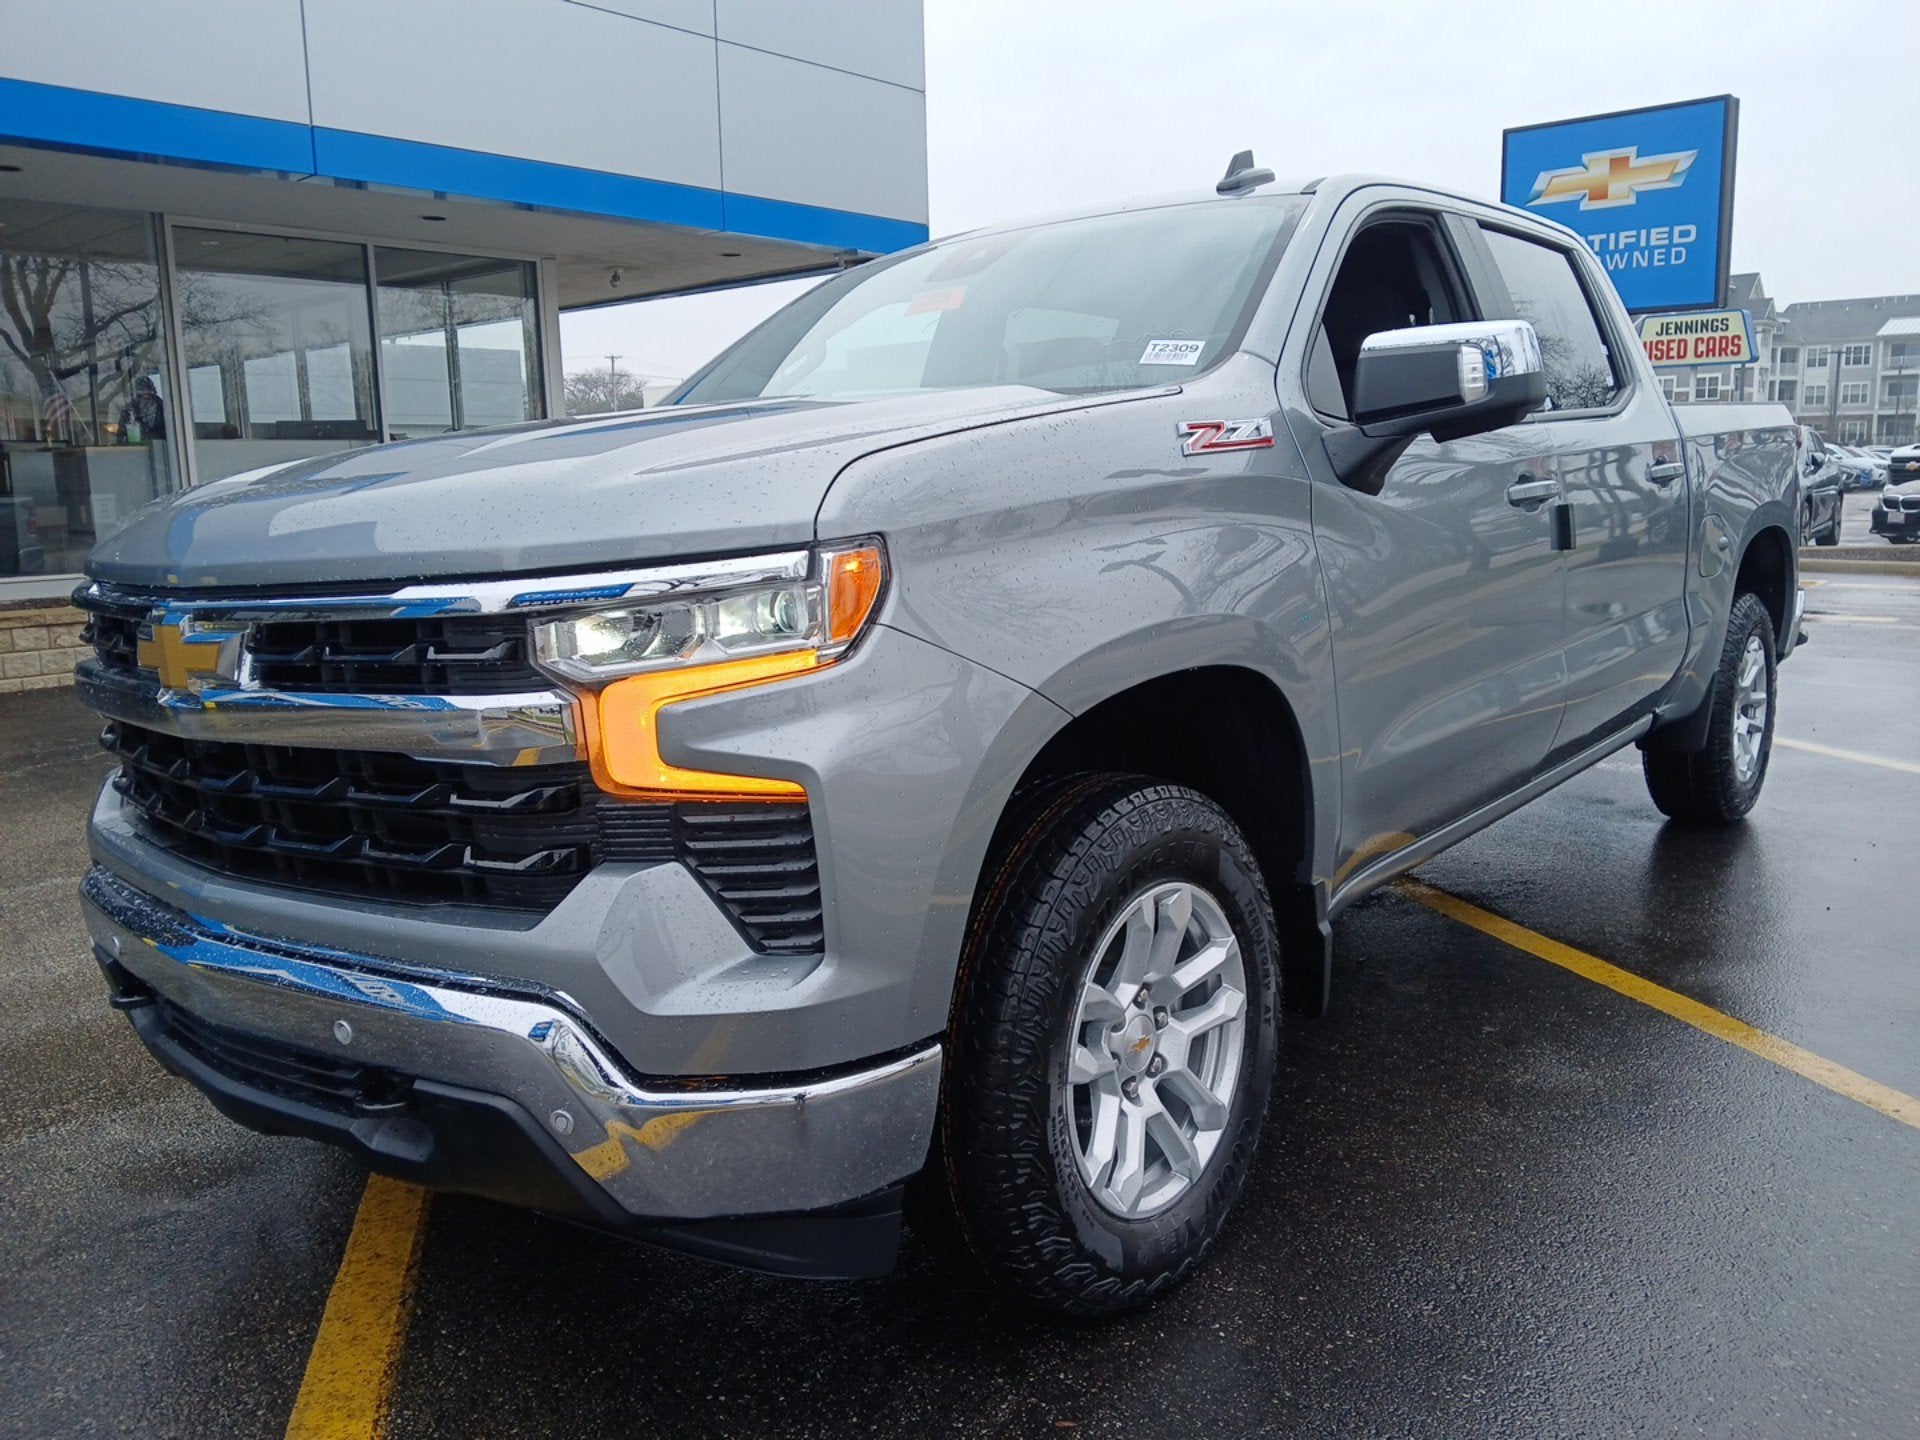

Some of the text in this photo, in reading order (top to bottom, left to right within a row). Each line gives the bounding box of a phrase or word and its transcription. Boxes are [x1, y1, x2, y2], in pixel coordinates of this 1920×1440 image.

[1582, 224, 1697, 252] TIFIED
[1598, 247, 1686, 270] WNED
[1655, 317, 1730, 337] JENNINGS
[1150, 343, 1200, 353] T2309
[1643, 334, 1742, 361] USED CARS
[1177, 417, 1276, 457] Z71
